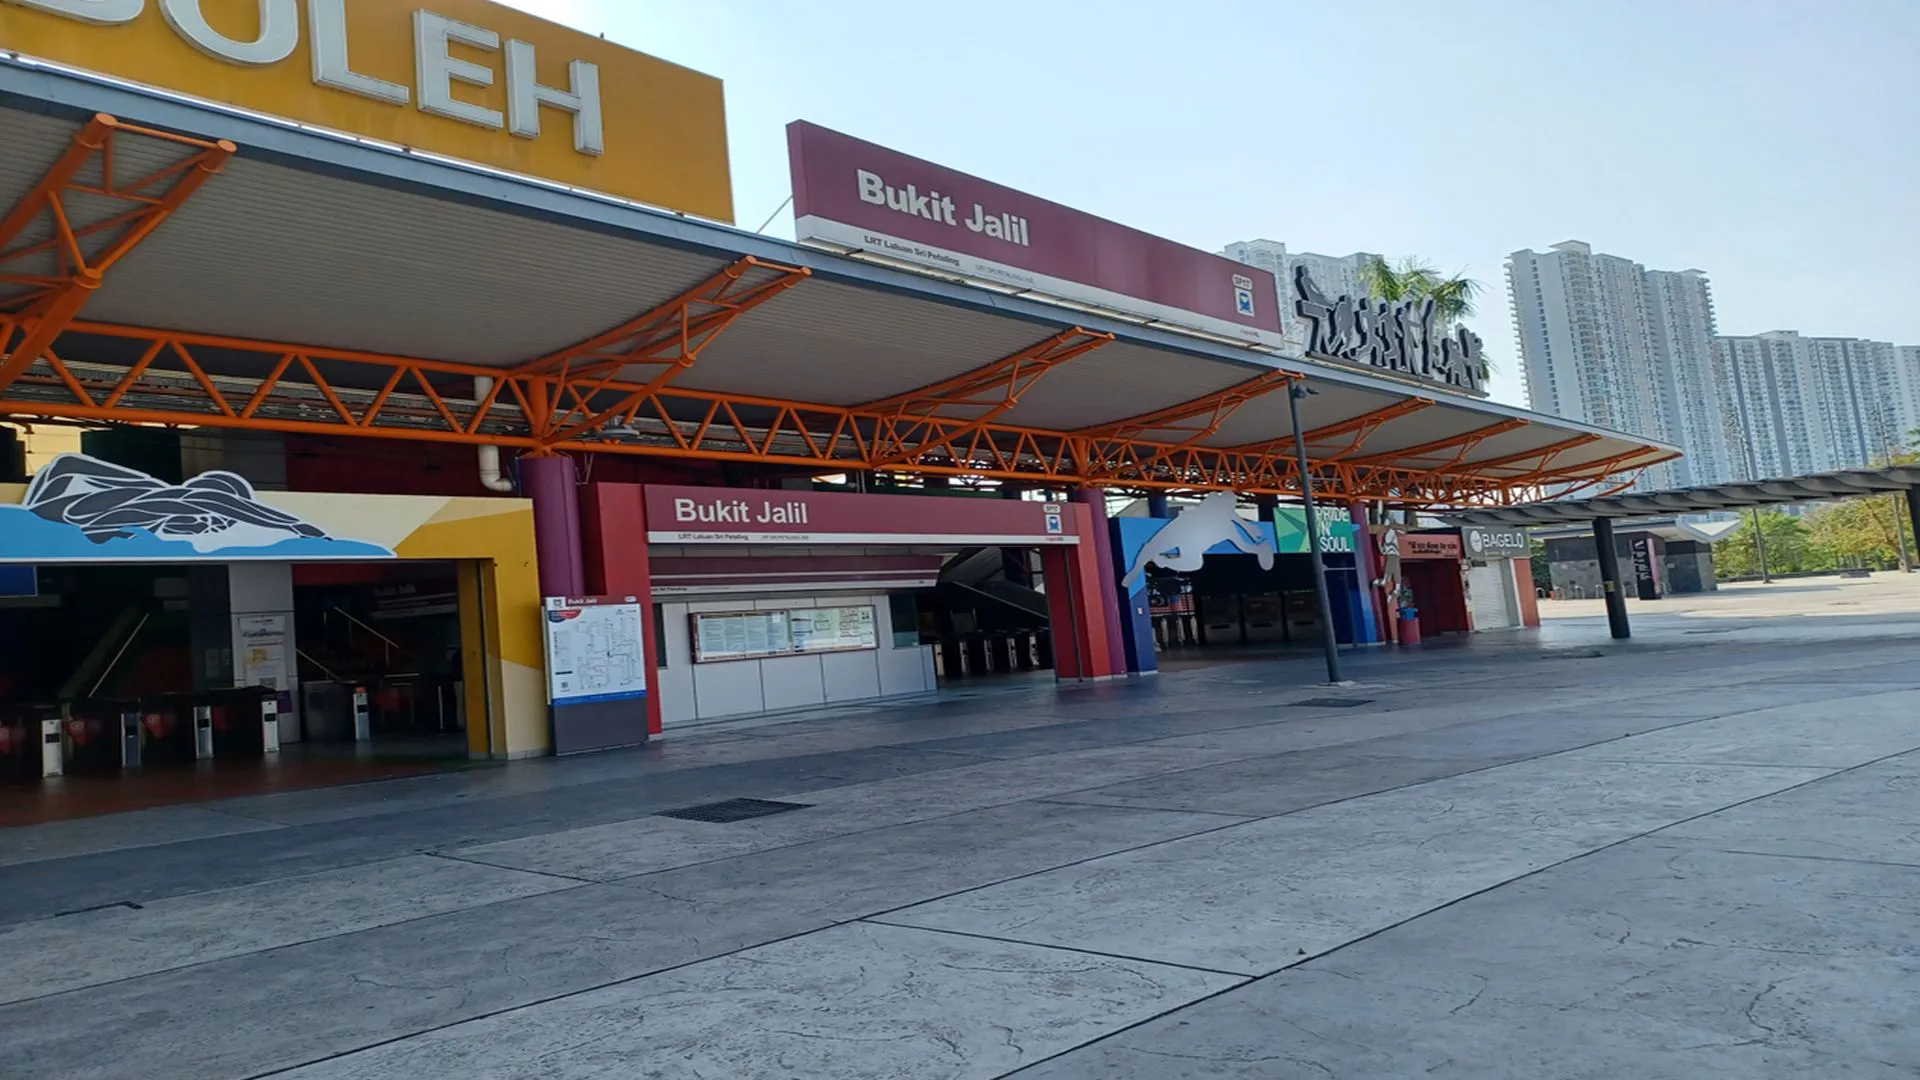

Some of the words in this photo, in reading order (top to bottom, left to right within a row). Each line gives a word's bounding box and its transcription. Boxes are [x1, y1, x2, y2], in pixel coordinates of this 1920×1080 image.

[8, 0, 604, 156] OLEH
[857, 169, 957, 226] Bukit
[965, 203, 1029, 247] Jalil
[674, 498, 750, 523] Bukit
[756, 501, 808, 524] Jalil
[1312, 506, 1350, 522] PRIDE
[1320, 536, 1351, 552] SOUL
